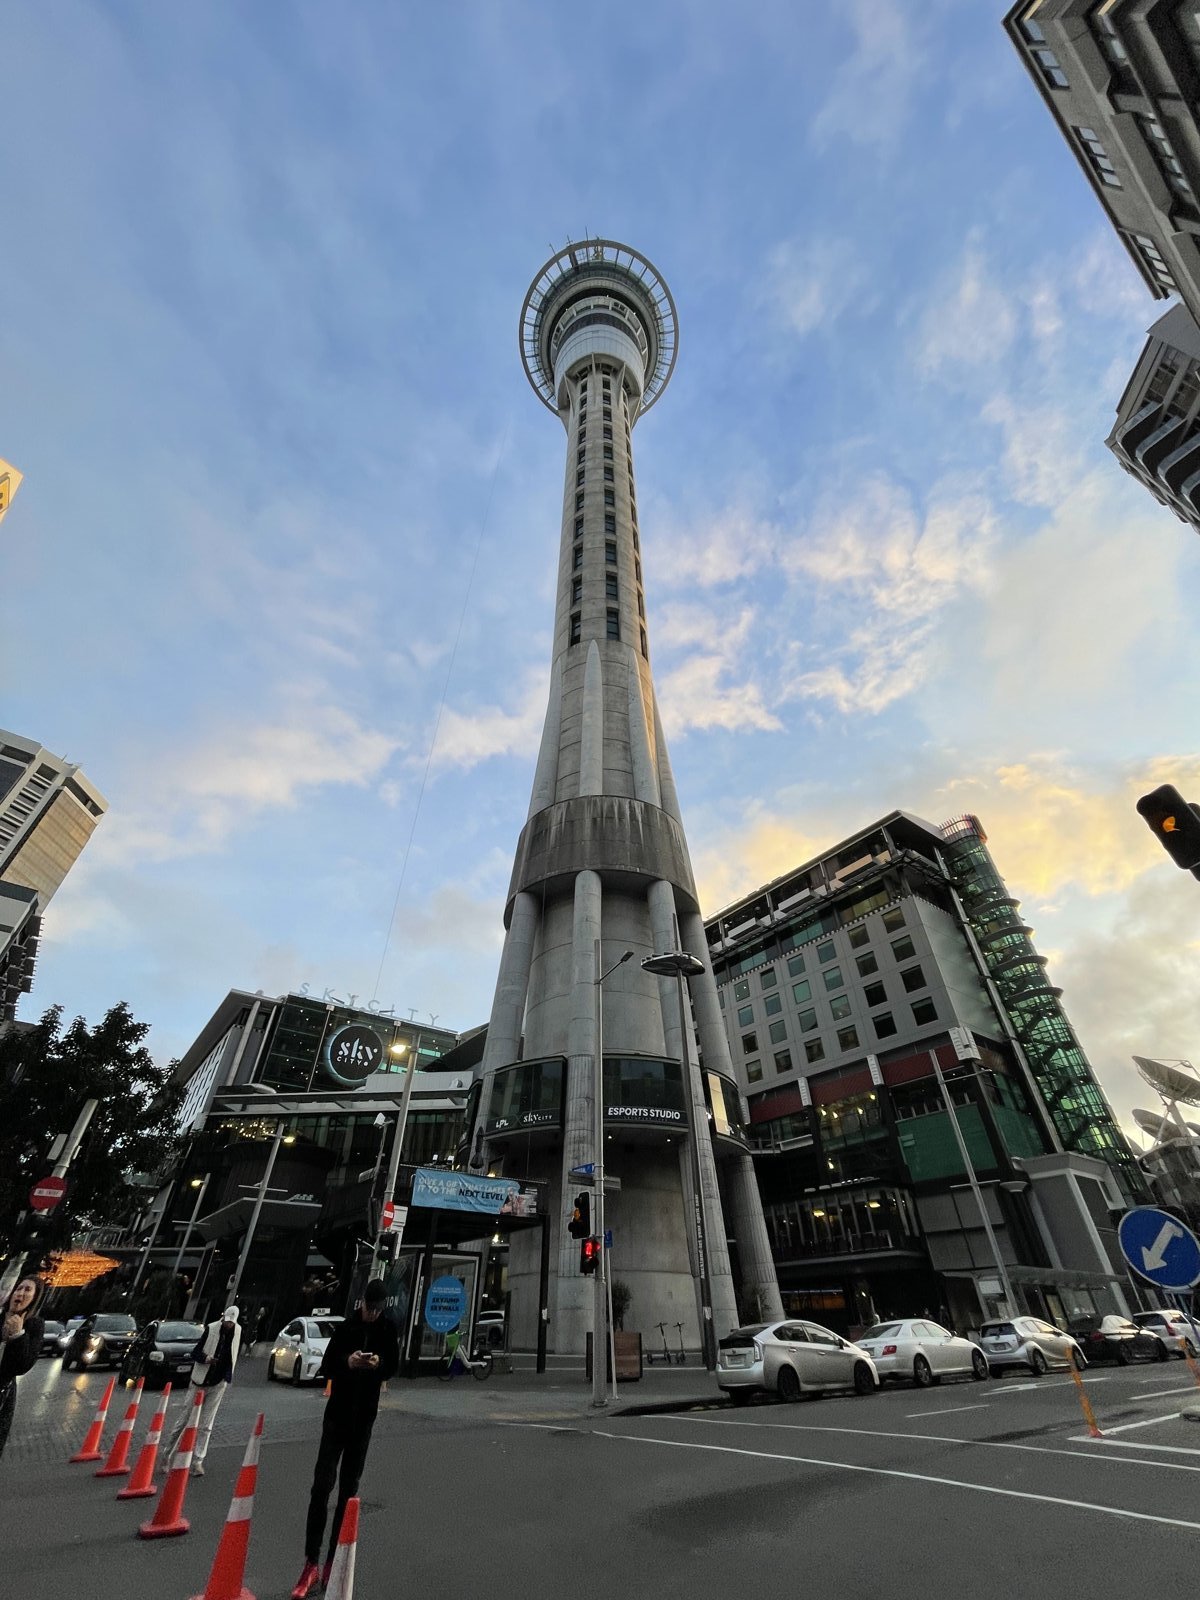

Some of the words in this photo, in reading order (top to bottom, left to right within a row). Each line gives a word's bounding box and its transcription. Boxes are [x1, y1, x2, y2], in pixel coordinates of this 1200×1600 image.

[336, 1055, 364, 1066] CITY
[608, 1107, 649, 1117] ESPORTS
[649, 1109, 681, 1120] STUDIO
[495, 1119, 509, 1128] LPL
[417, 1184, 426, 1192] IT
[428, 1185, 439, 1194] TO
[441, 1186, 458, 1196] THE
[459, 1188, 480, 1198] NEXT
[481, 1191, 504, 1201] LEVEL
